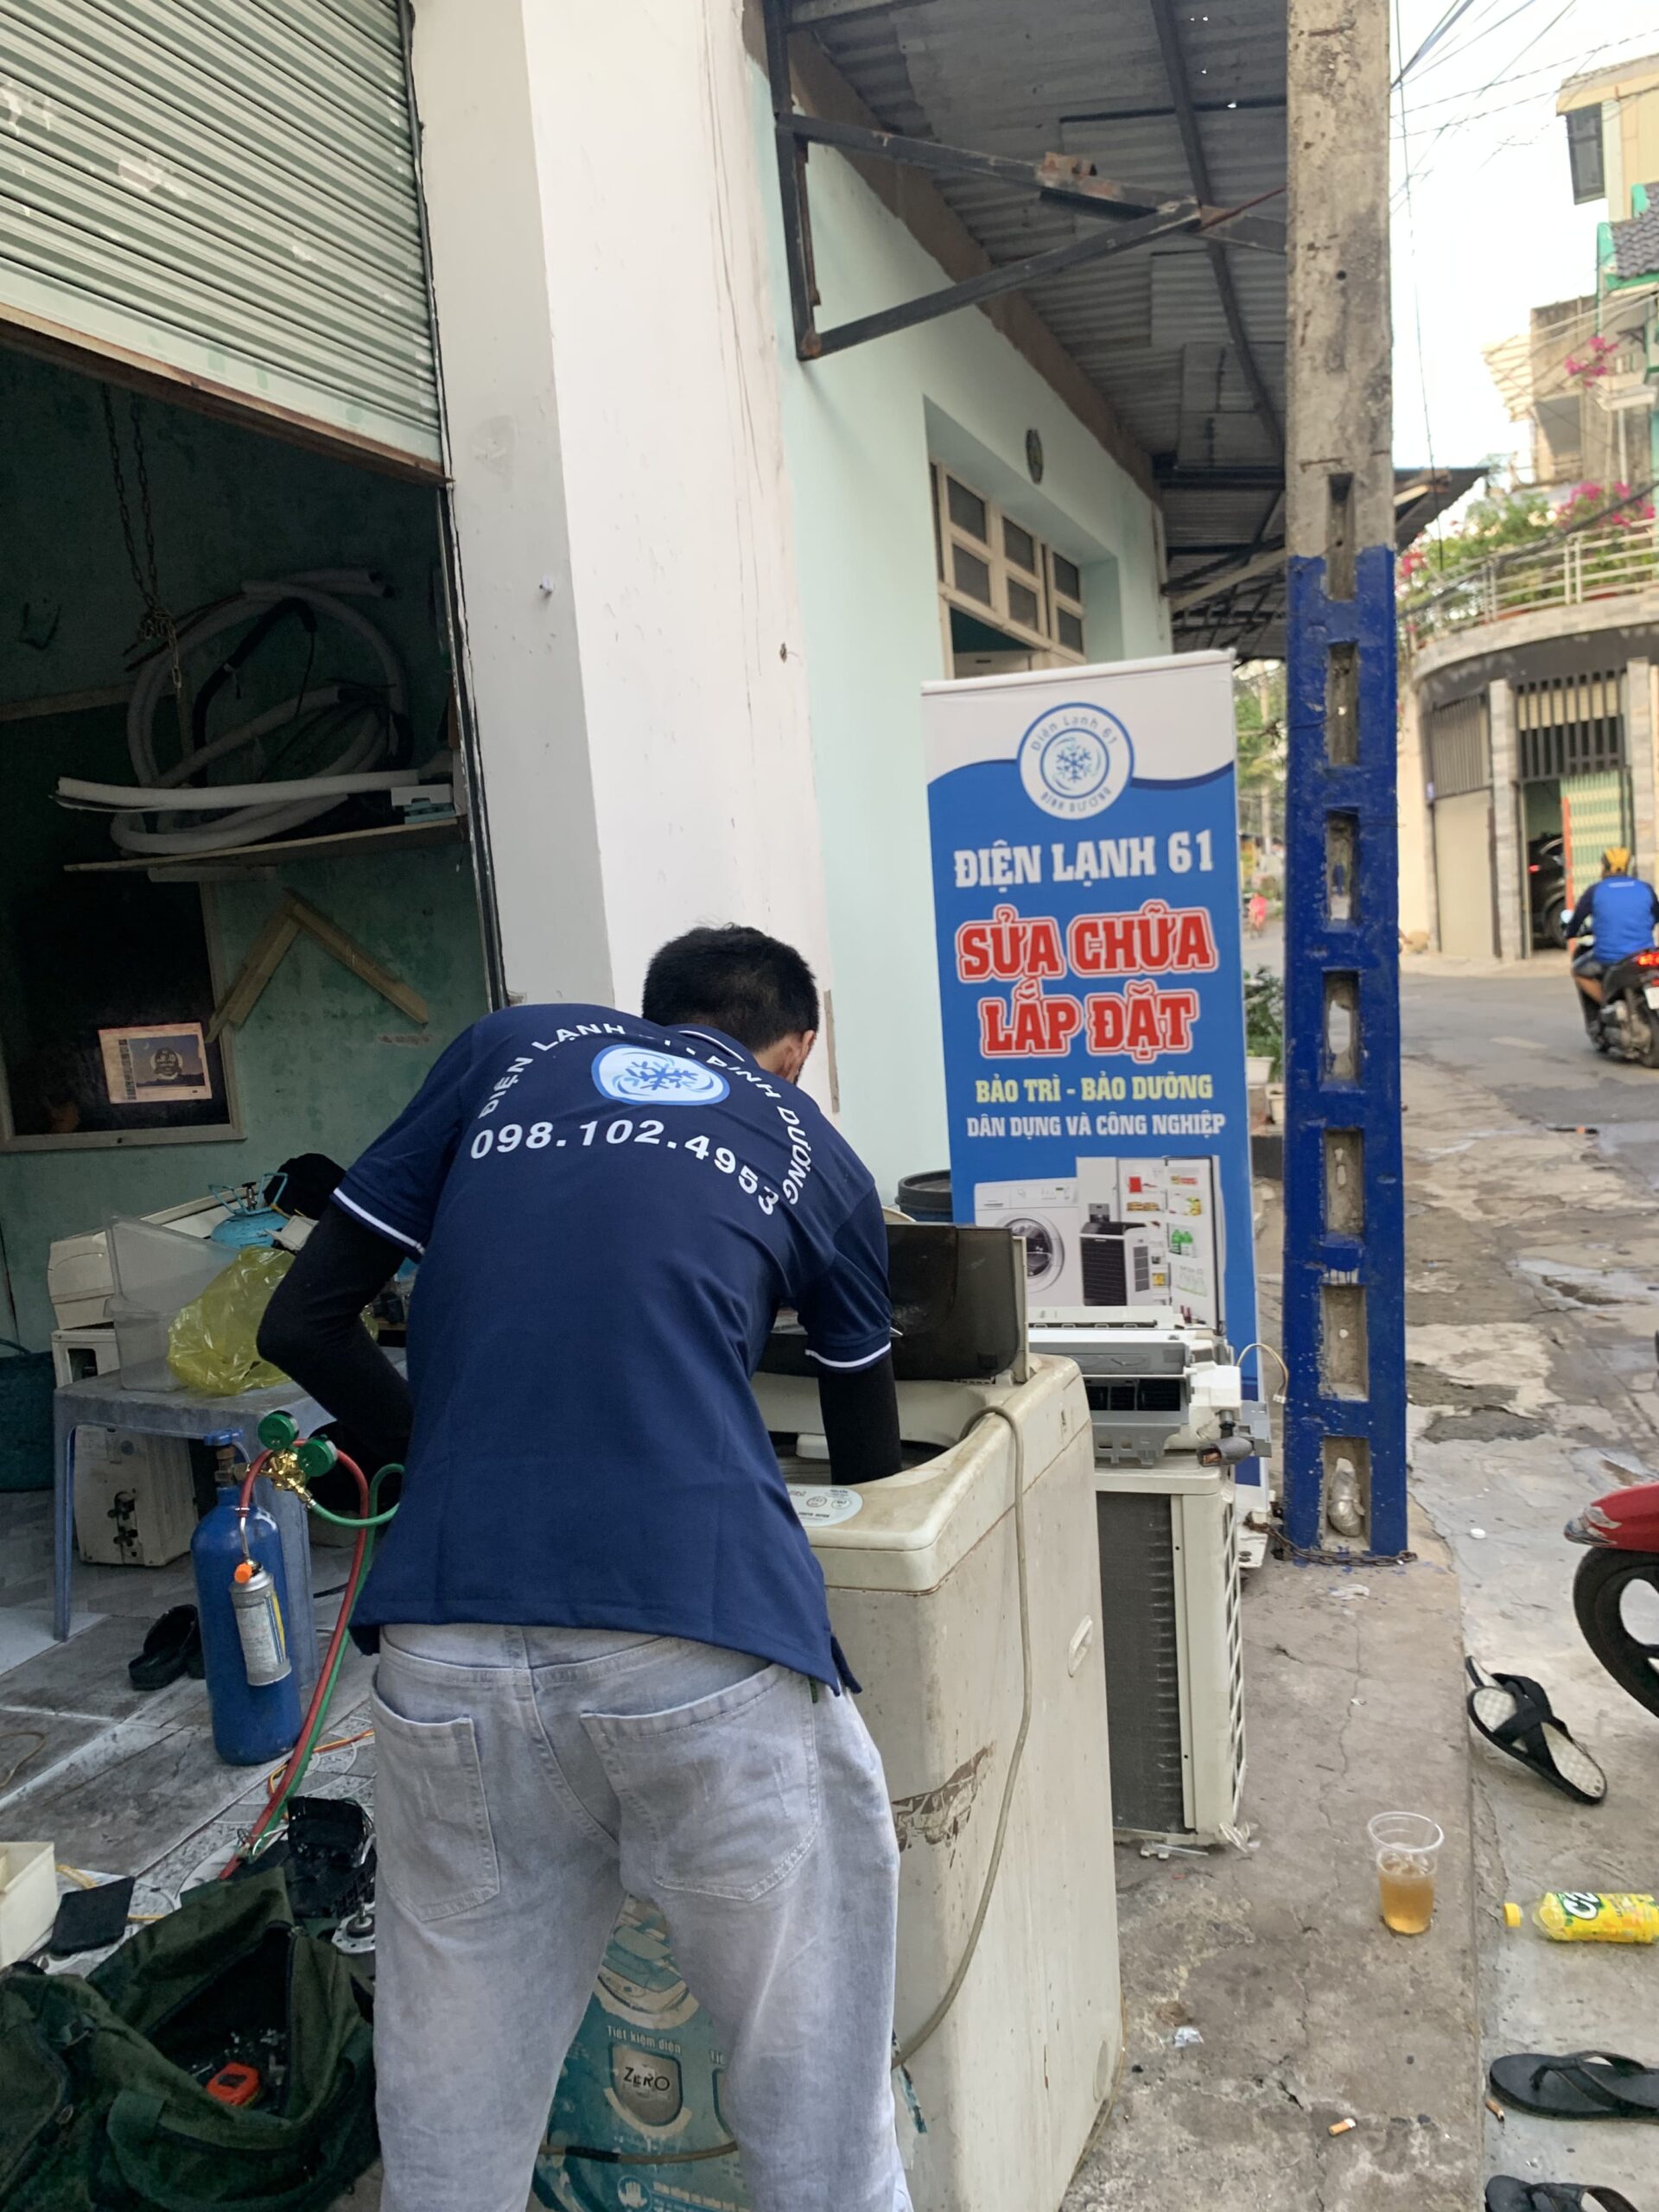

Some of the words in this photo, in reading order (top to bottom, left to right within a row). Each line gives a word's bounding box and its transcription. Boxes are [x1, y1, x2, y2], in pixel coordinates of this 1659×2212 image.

[1102, 728, 1117, 744] 61
[954, 840, 1041, 893] ĐIỆN
[1052, 836, 1156, 887] LẠNH
[1167, 830, 1214, 874] 61
[955, 903, 1066, 982] SỬA
[1067, 899, 1218, 977] CHỮA
[978, 976, 1083, 1058] LẮP
[1085, 979, 1199, 1064] ĐẶT
[532, 1022, 626, 1052] LẠNH
[976, 1073, 1019, 1103] BẢO
[1023, 1073, 1061, 1102] TRÌ
[1081, 1071, 1126, 1101] BẢO
[967, 1113, 1005, 1137] DÂN
[1009, 1116, 1061, 1140] DỤNG
[1065, 1111, 1092, 1136] VÀ
[1096, 1111, 1147, 1135] CÔNG
[1151, 1109, 1225, 1138] NGHIỆP
[470, 1119, 779, 1216] 098.102.4953
[623, 2066, 671, 2091] ZERO
